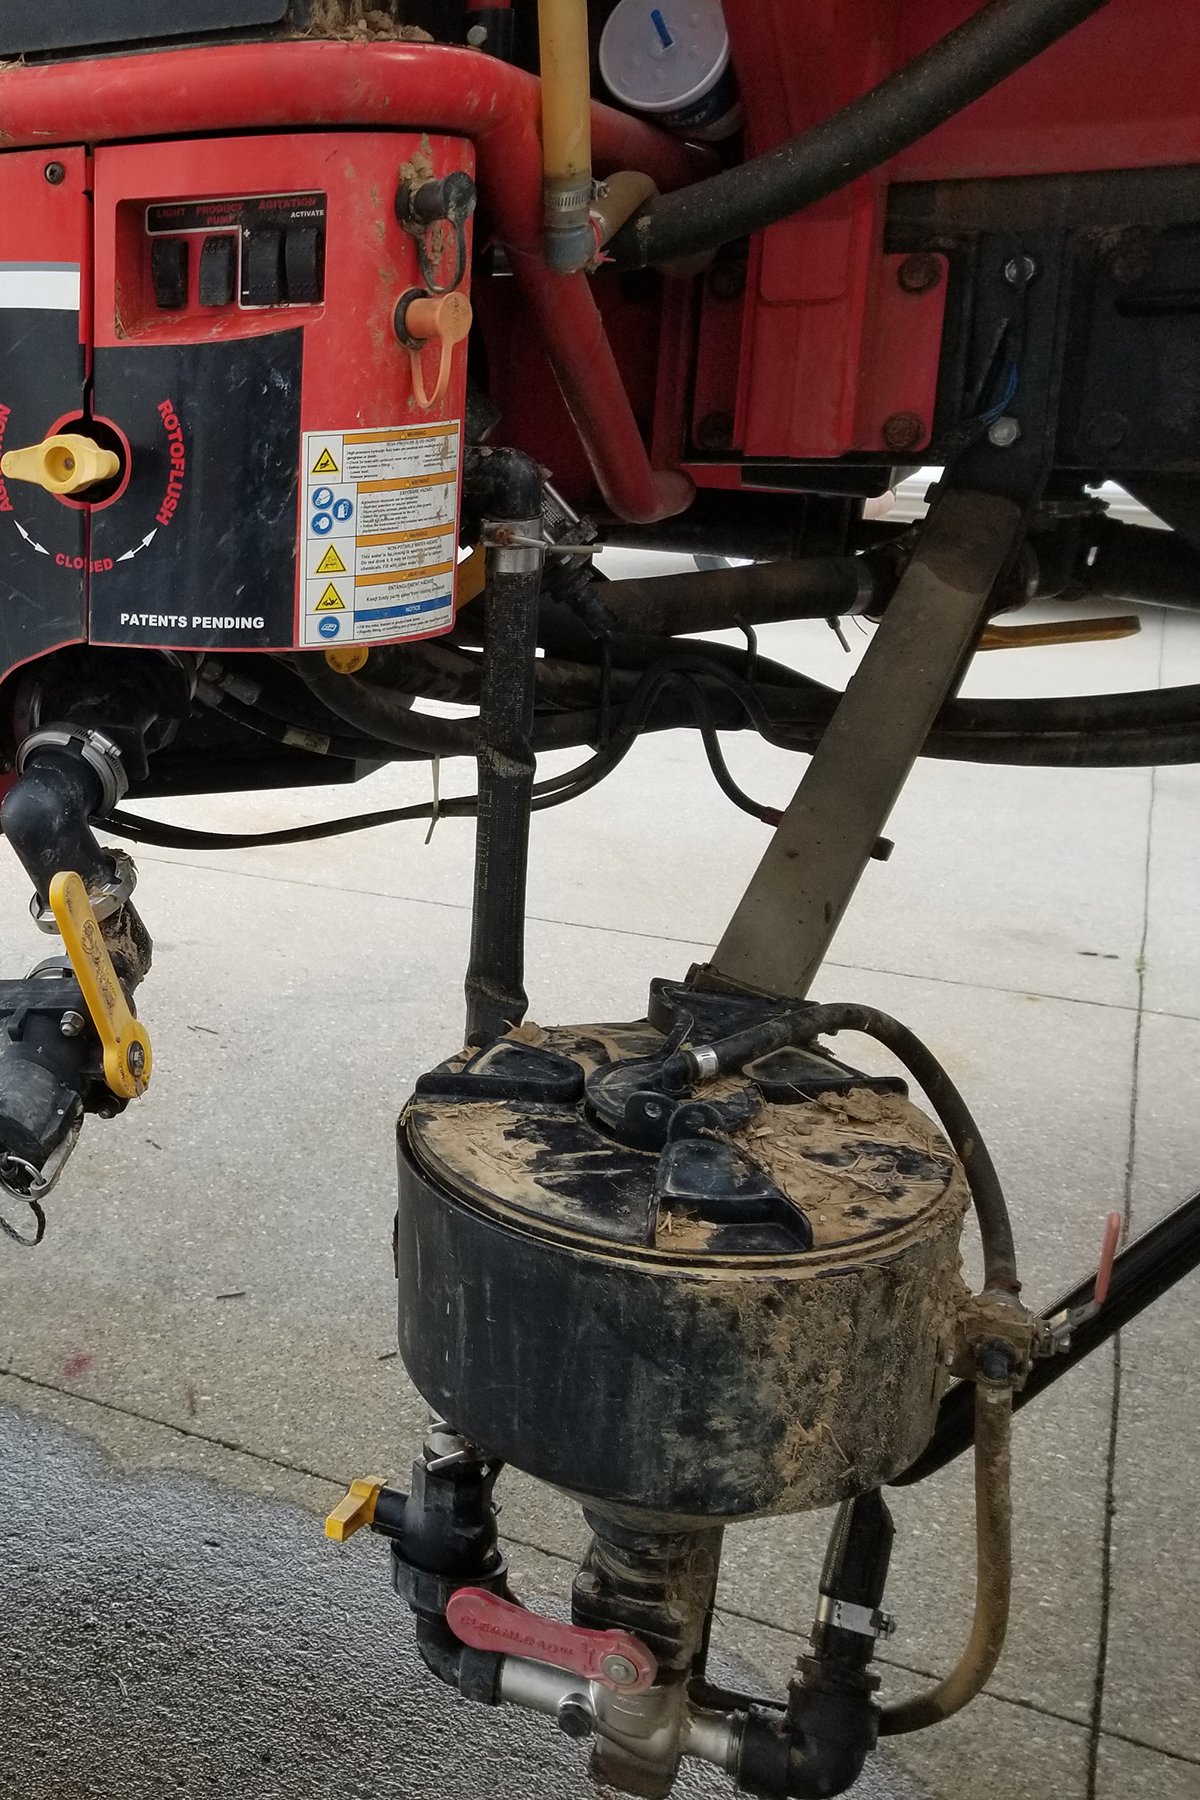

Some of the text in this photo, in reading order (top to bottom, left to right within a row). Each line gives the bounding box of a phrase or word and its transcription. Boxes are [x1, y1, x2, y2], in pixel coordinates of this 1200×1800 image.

[195, 202, 244, 214] PRODUCT
[258, 198, 317, 210] AGITATION
[156, 207, 187, 218] LIGHT
[290, 209, 325, 219] ACTIVATE
[205, 215, 235, 225] PUMP
[155, 398, 186, 527] ROTOFLUSH
[55, 552, 113, 574] CLOSED
[120, 613, 265, 630] PATENTS PENDING
